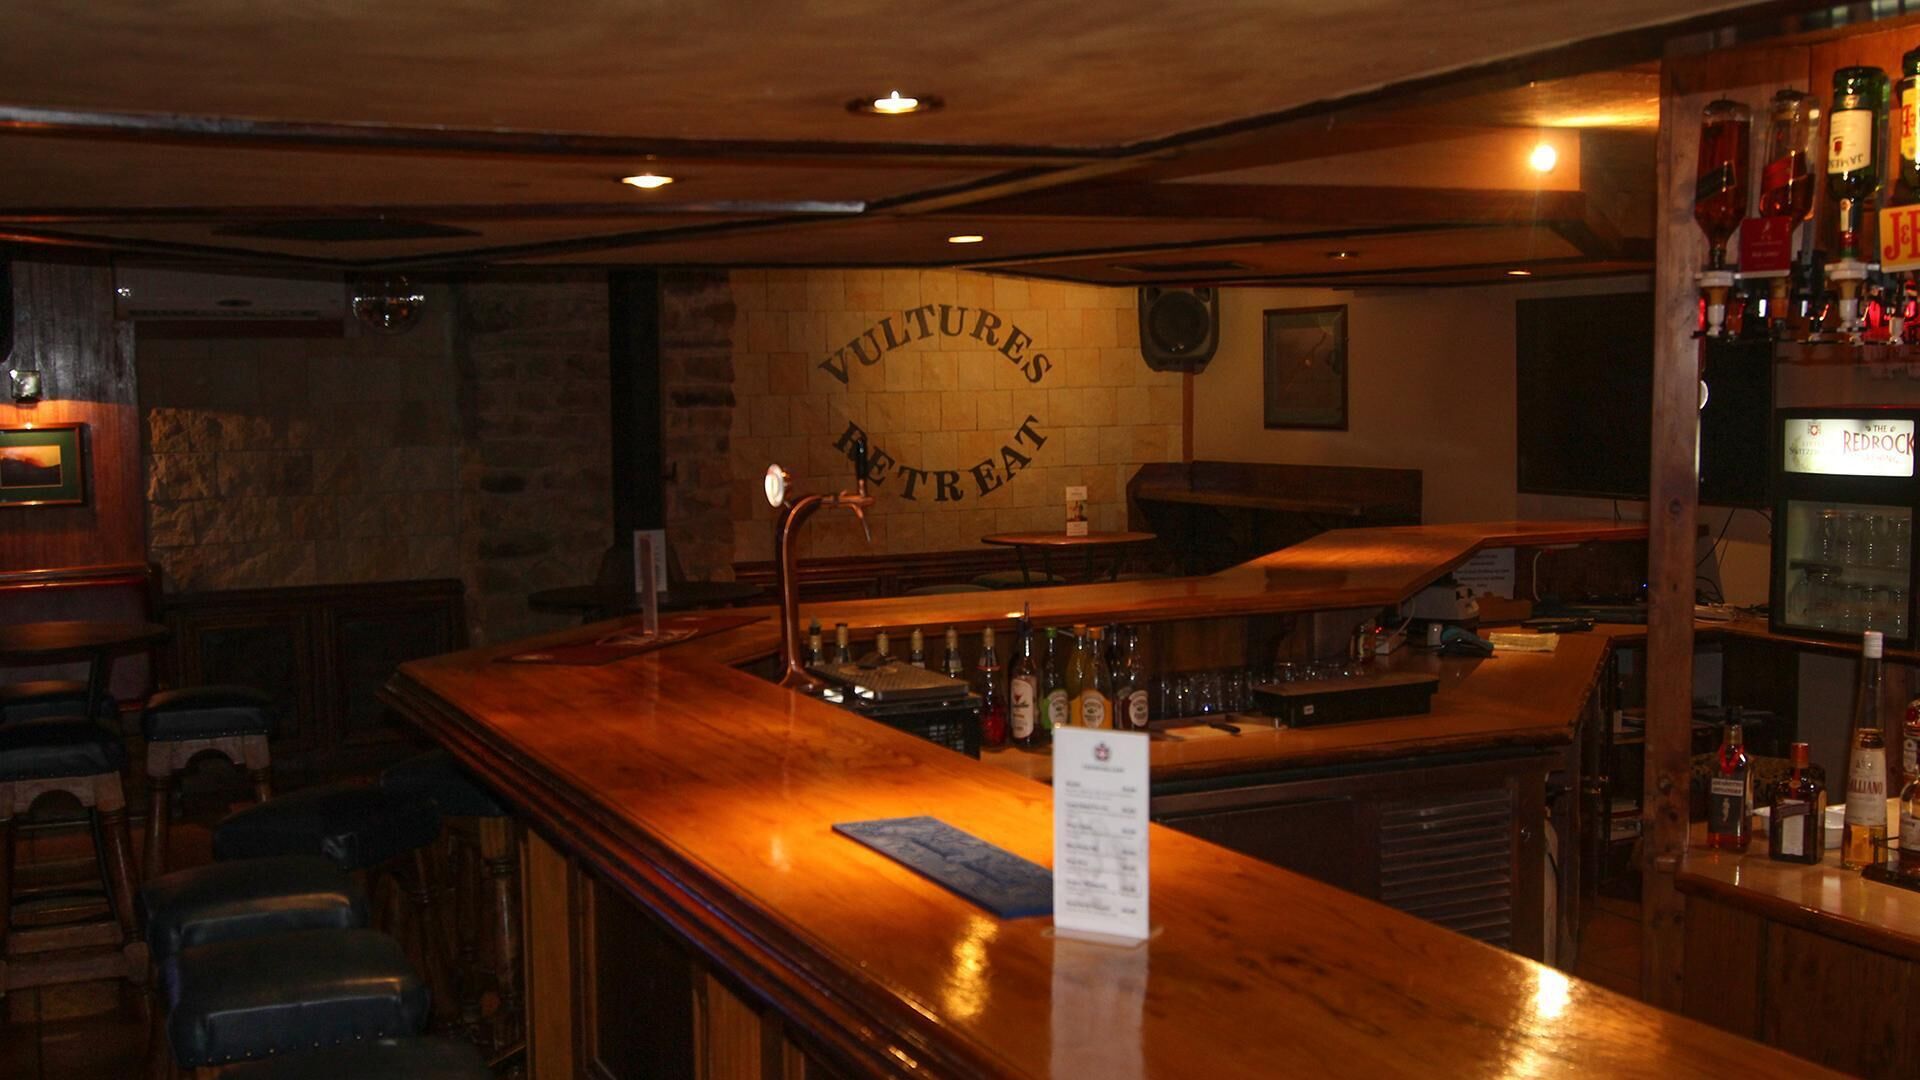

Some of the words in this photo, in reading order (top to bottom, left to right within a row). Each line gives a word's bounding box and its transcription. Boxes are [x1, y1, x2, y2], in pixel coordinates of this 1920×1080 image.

[818, 304, 1053, 385] VULTURES
[1843, 430, 1915, 456] REDROCK
[1873, 424, 1887, 433] THE
[832, 414, 1049, 502] RETREAT
